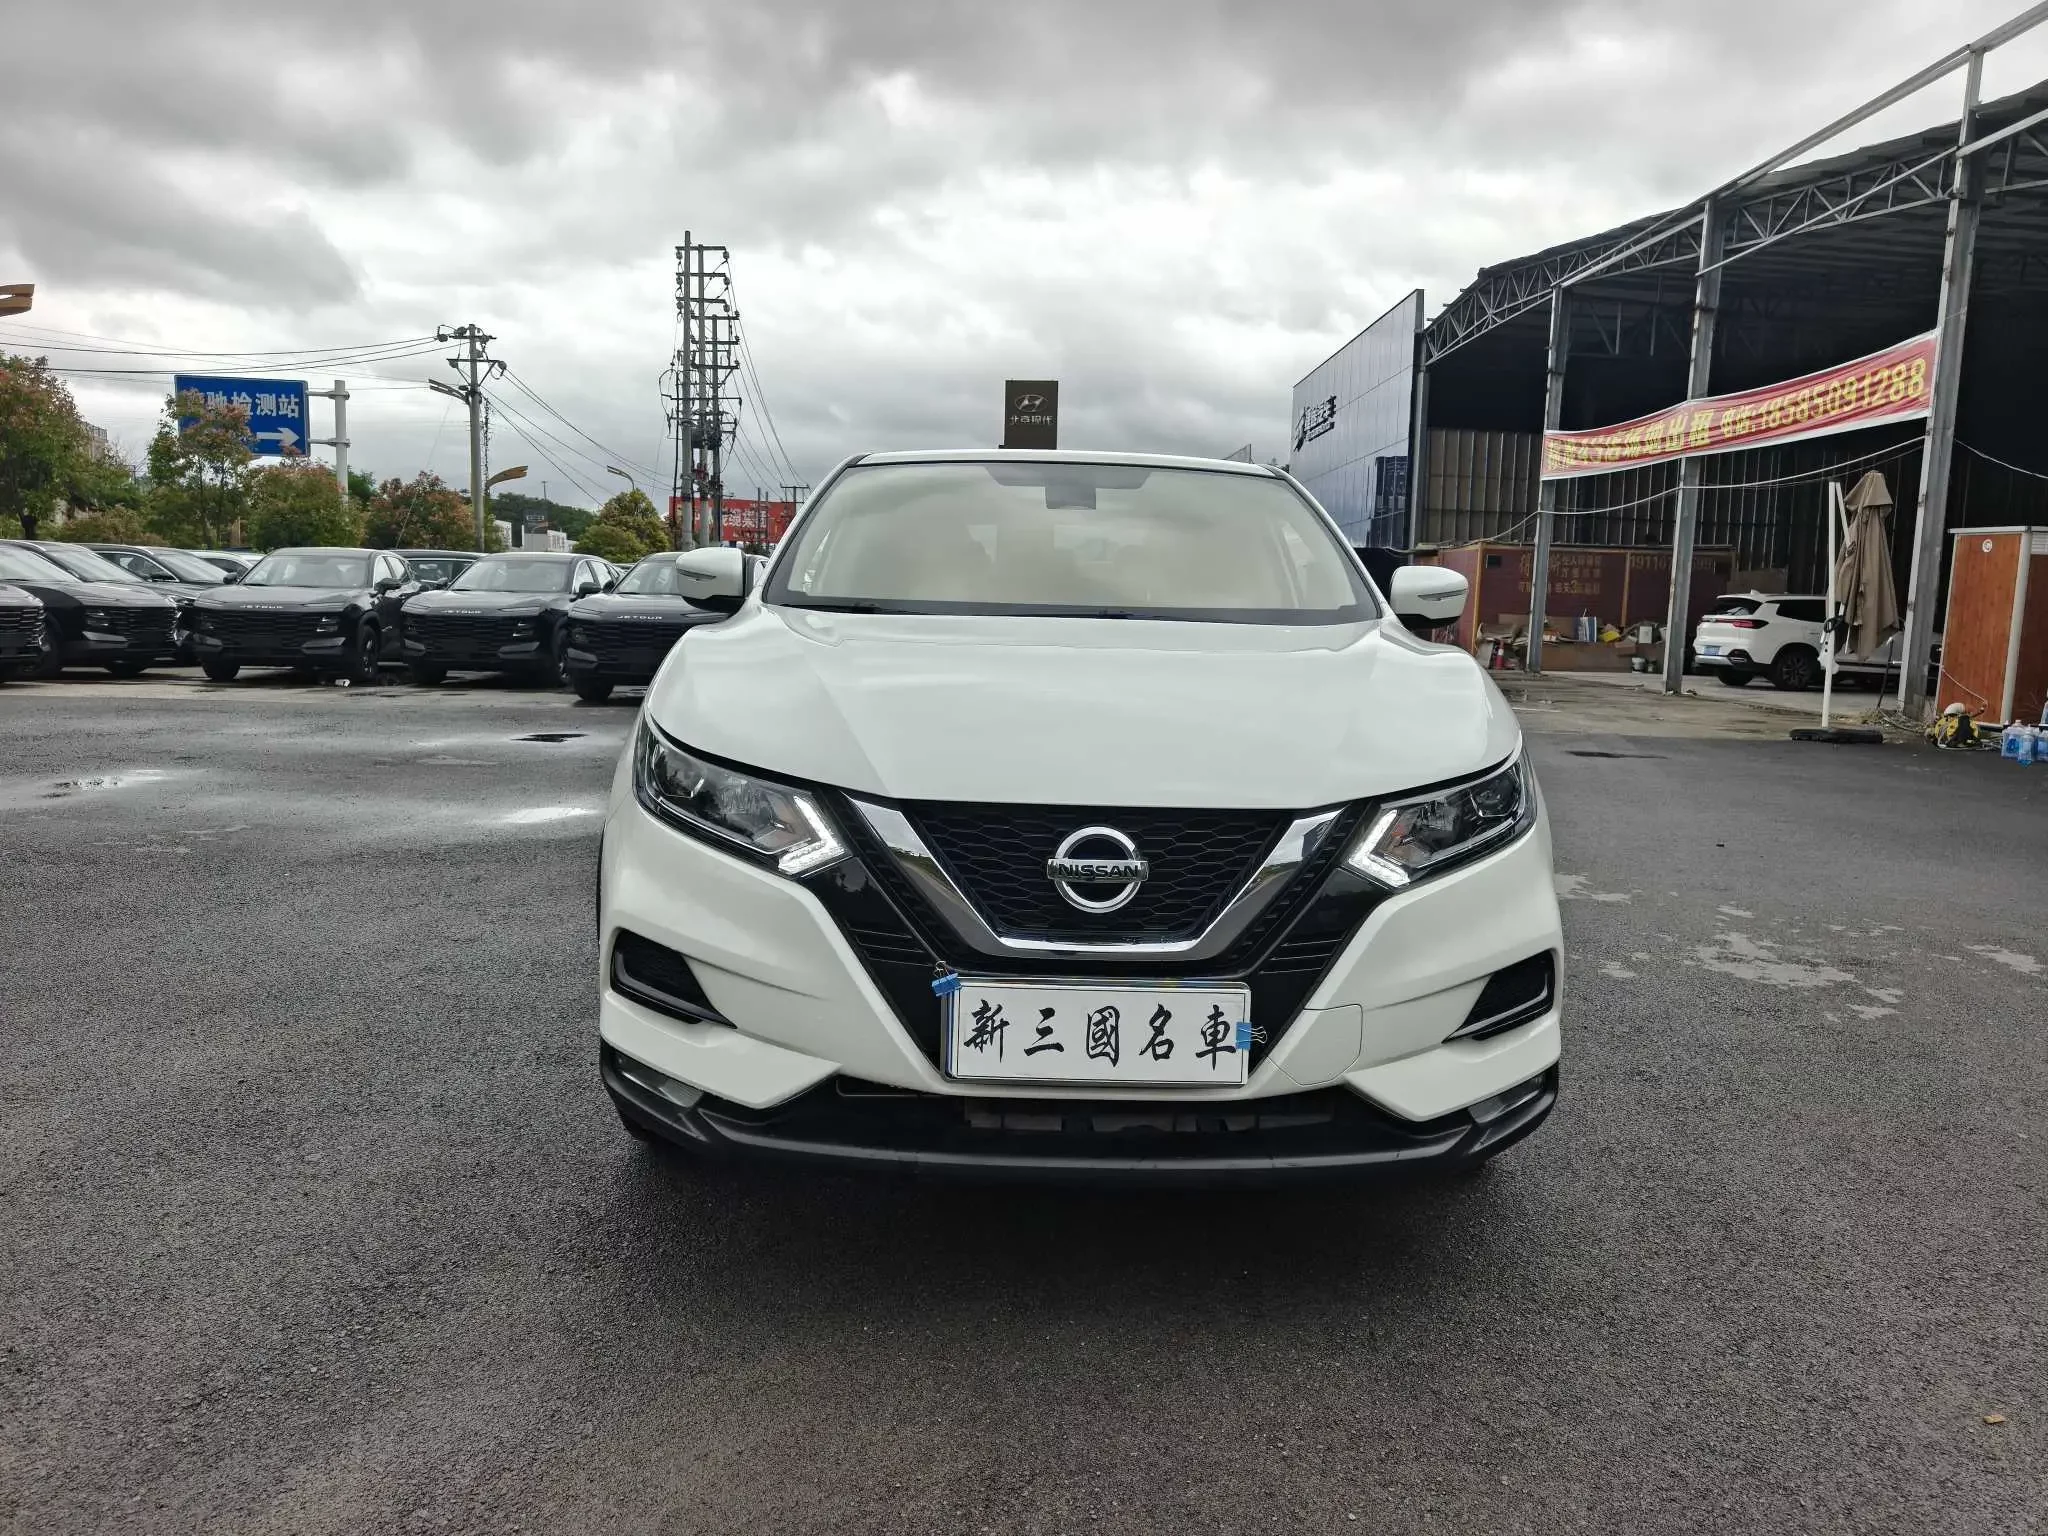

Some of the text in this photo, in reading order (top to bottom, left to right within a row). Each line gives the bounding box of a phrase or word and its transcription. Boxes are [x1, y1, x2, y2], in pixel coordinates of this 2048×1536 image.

[1059, 864, 1138, 877] NISSAN
[964, 999, 1237, 1070] 新三國名車
